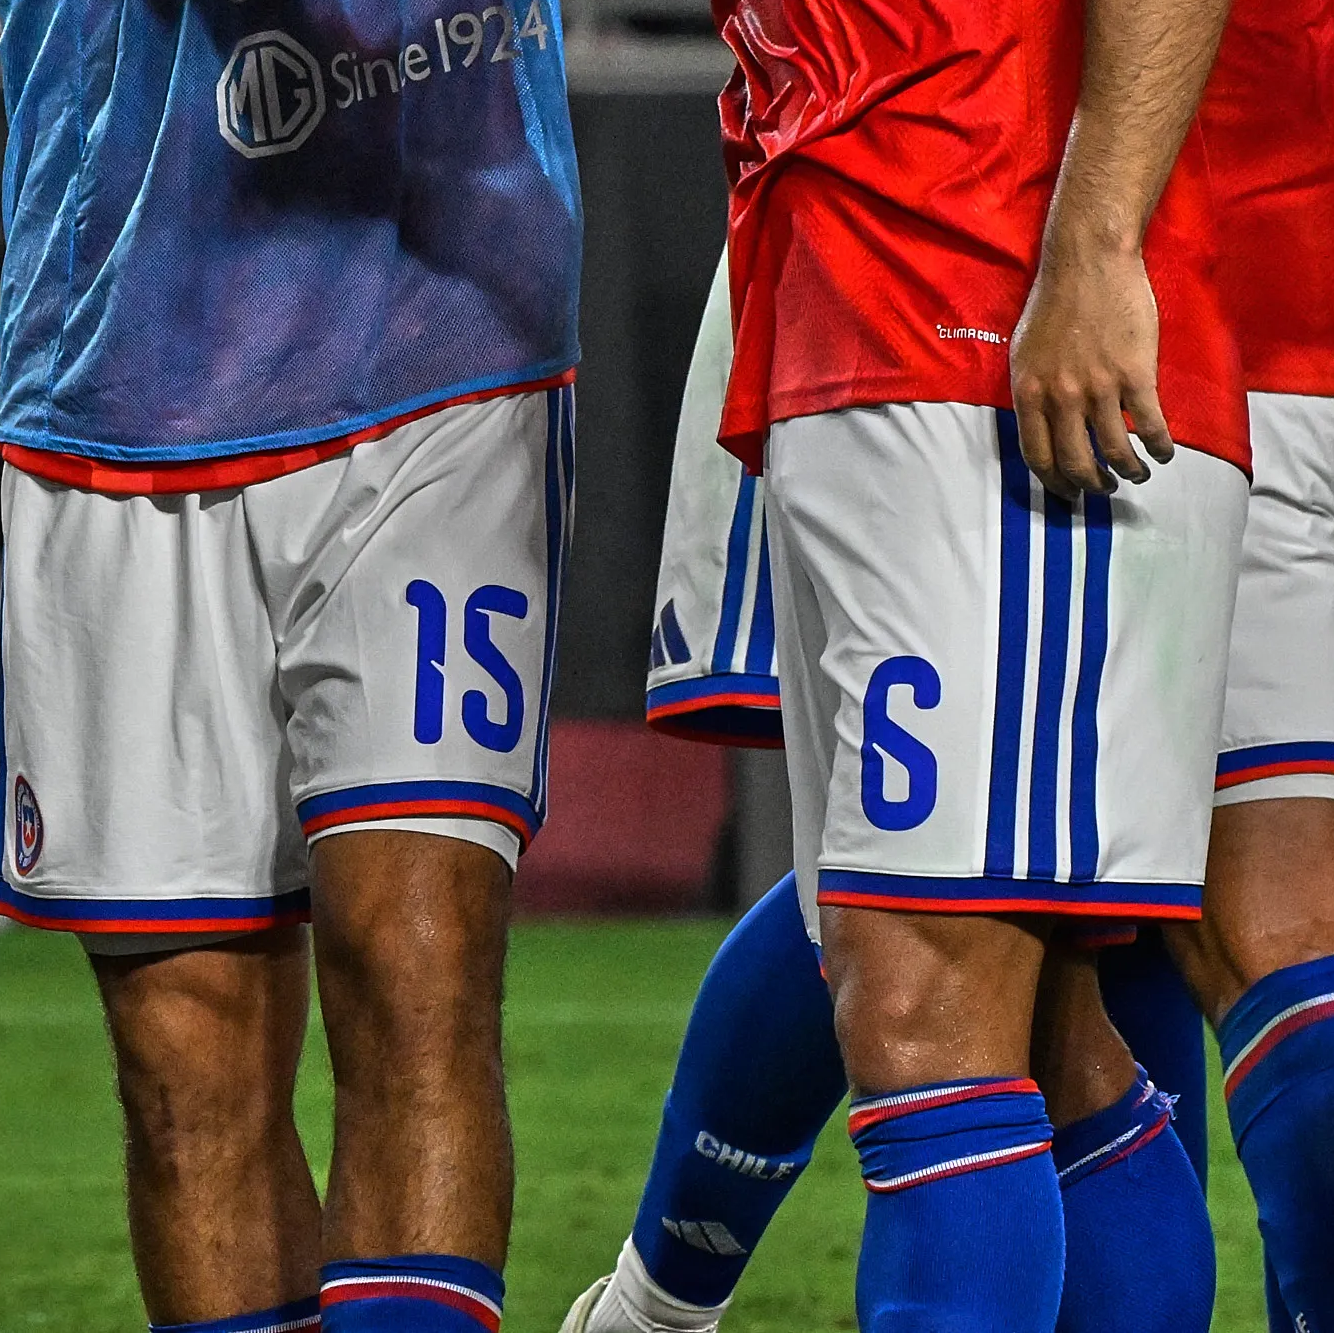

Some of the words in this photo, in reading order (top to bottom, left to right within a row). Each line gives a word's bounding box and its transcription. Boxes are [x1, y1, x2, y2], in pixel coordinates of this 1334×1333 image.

[406, 578, 529, 753] 15
[860, 655, 942, 832] 6
[695, 1130, 795, 1181] CHILE
